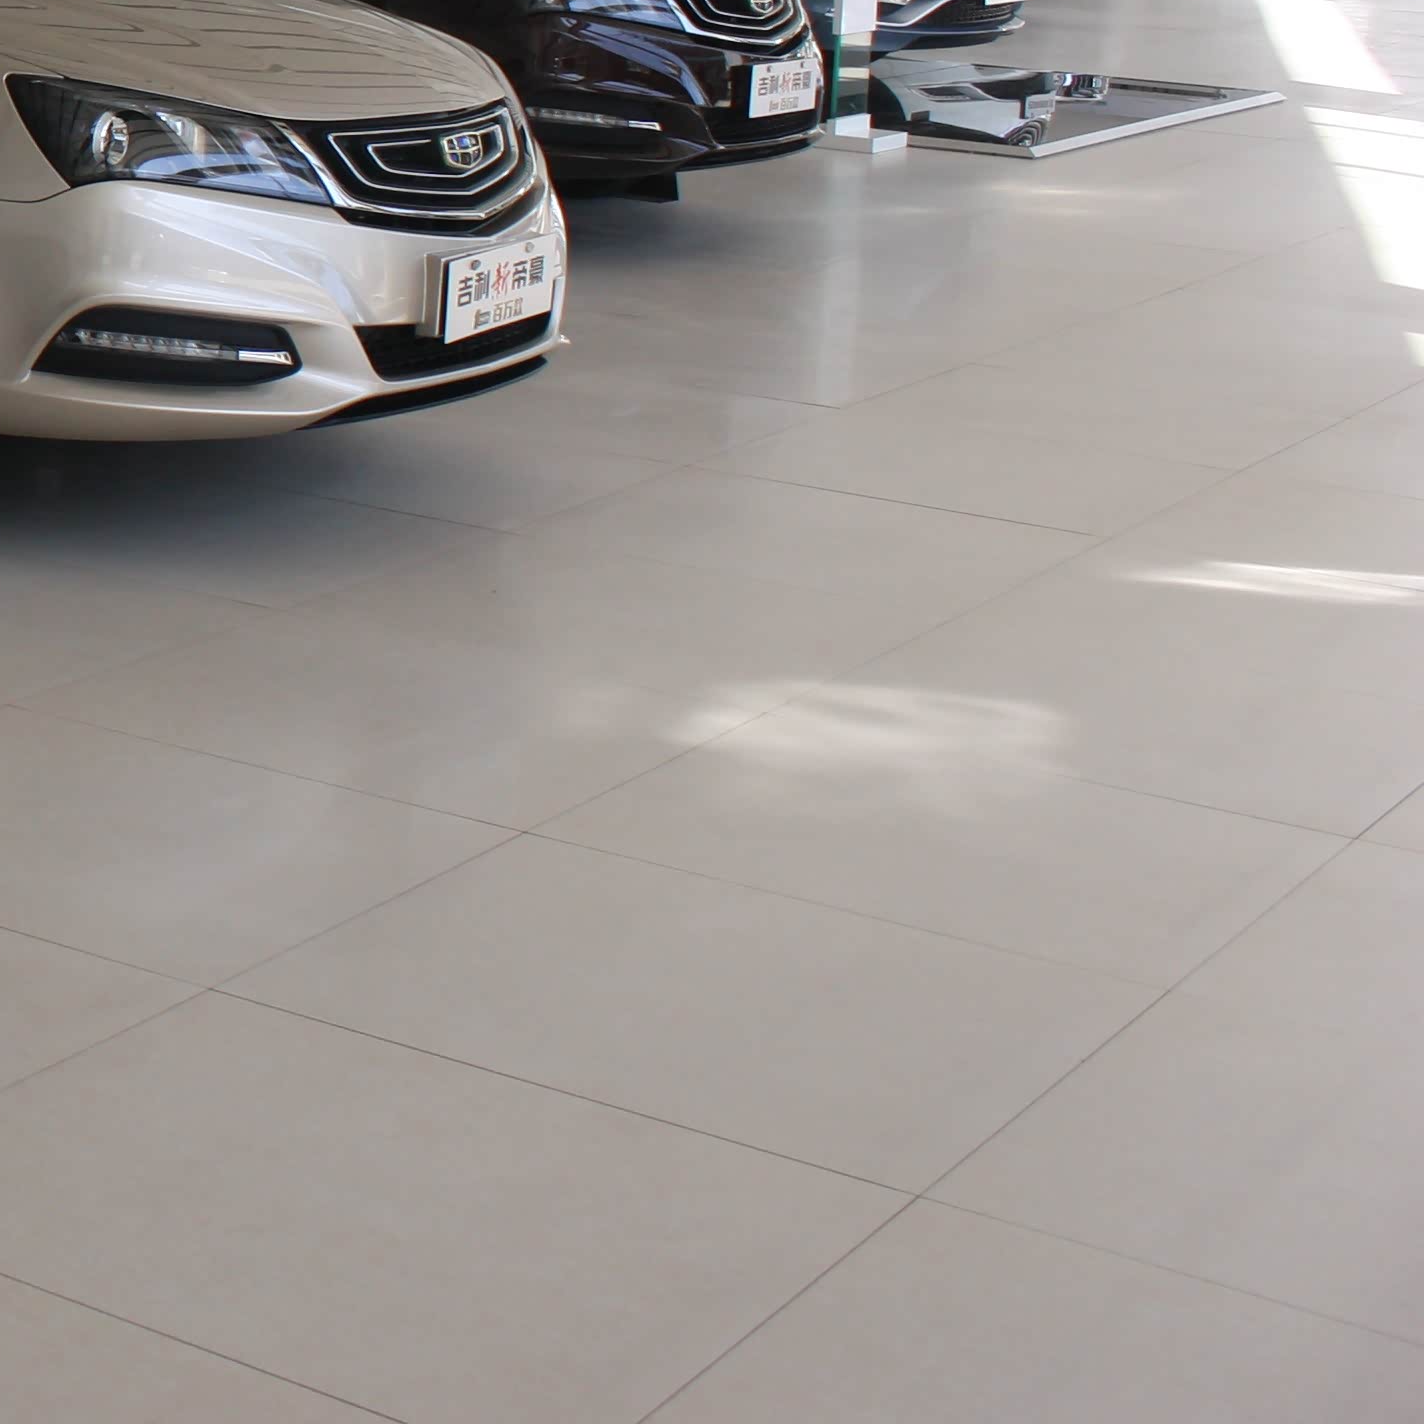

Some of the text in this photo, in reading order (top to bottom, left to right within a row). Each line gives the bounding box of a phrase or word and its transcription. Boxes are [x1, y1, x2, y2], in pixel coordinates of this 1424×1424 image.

[457, 255, 545, 308] 吉利新帝豪
[493, 297, 524, 323] 百万款
